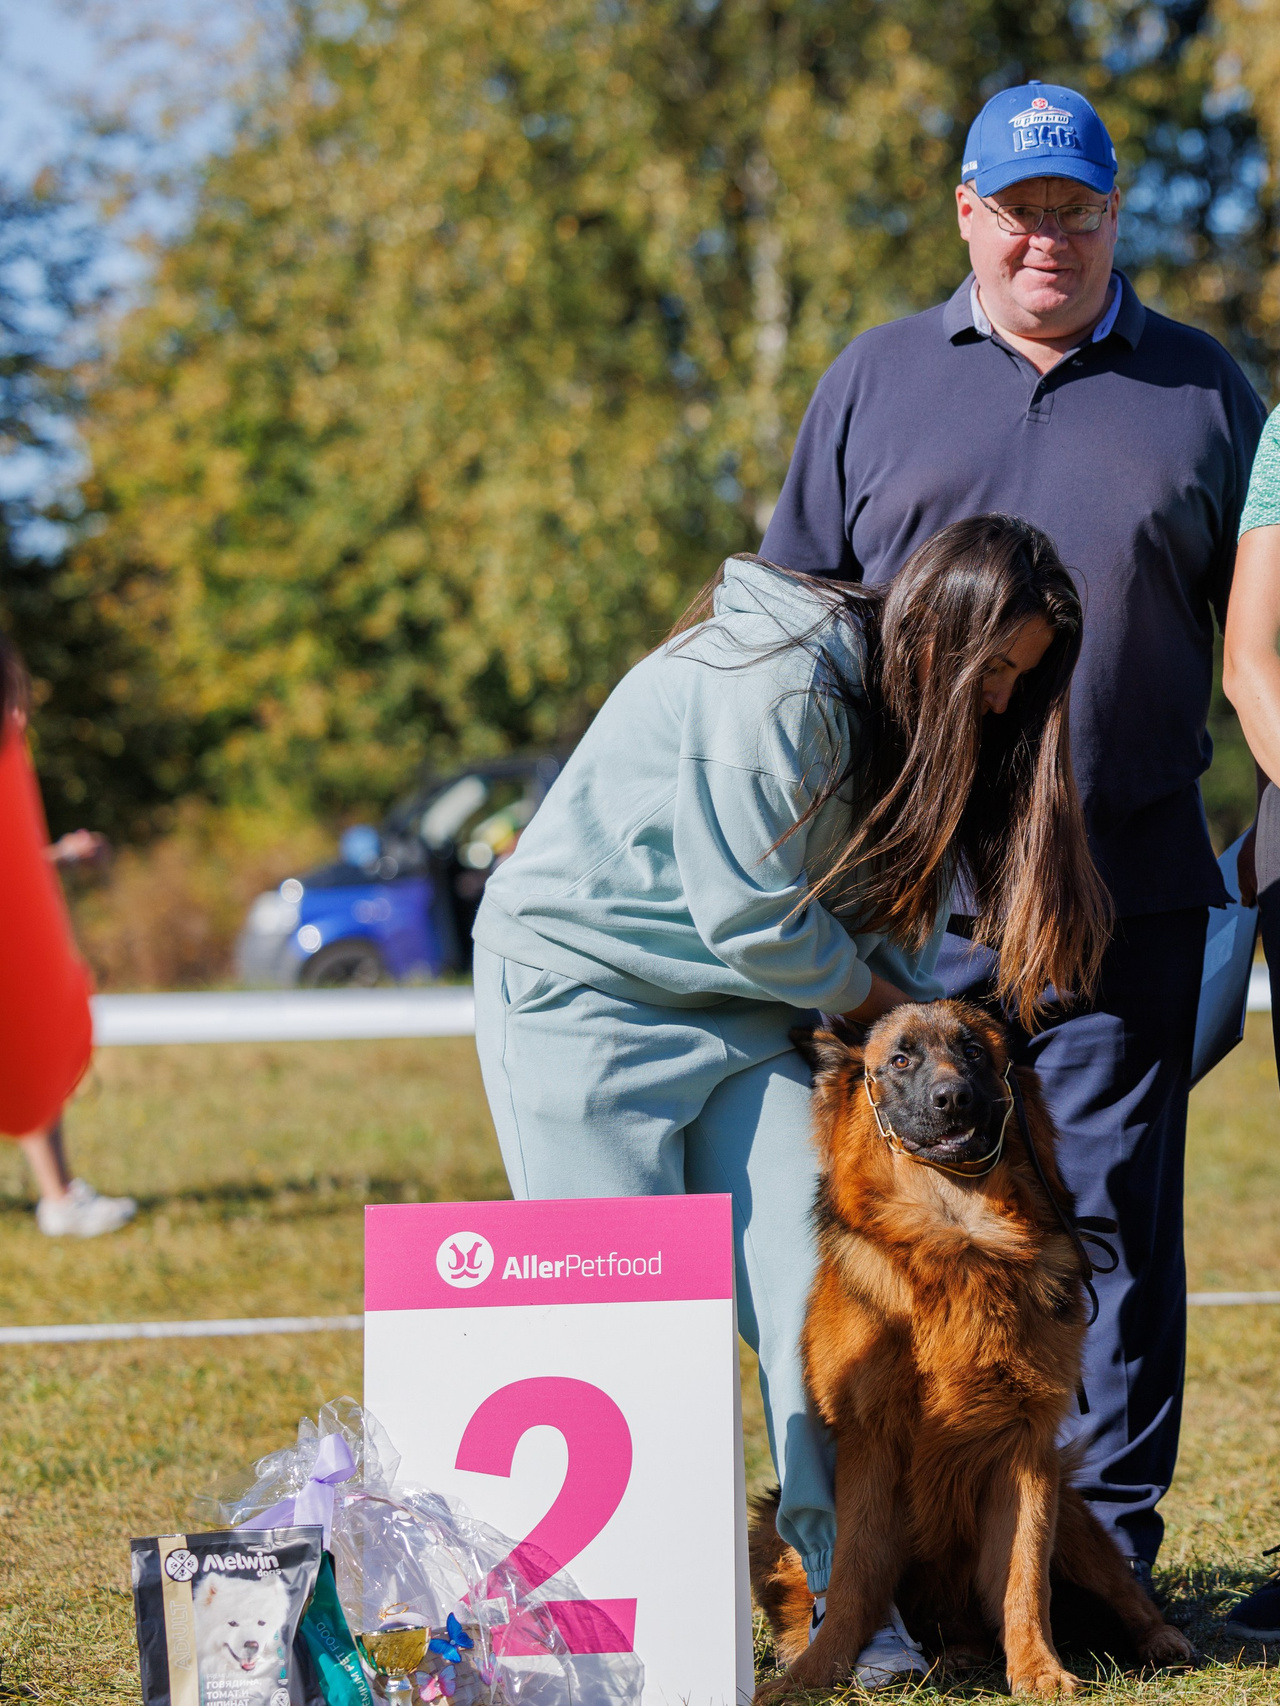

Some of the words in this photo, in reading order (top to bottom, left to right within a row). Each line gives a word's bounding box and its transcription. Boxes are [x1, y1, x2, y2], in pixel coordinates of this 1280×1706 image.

[1013, 125, 1075, 153] 1946
[501, 1250, 662, 1280] AllerPetfood
[454, 1376, 638, 1658] 2
[202, 1551, 280, 1573] Melwin
[256, 1568, 283, 1578] dogs
[169, 1599, 193, 1671] ADULT
[316, 1621, 340, 1652] FOOD
[335, 1652, 355, 1672] PET
[206, 1690, 240, 1700] ТОМАТ
[350, 1671, 371, 1706] EMIUM
